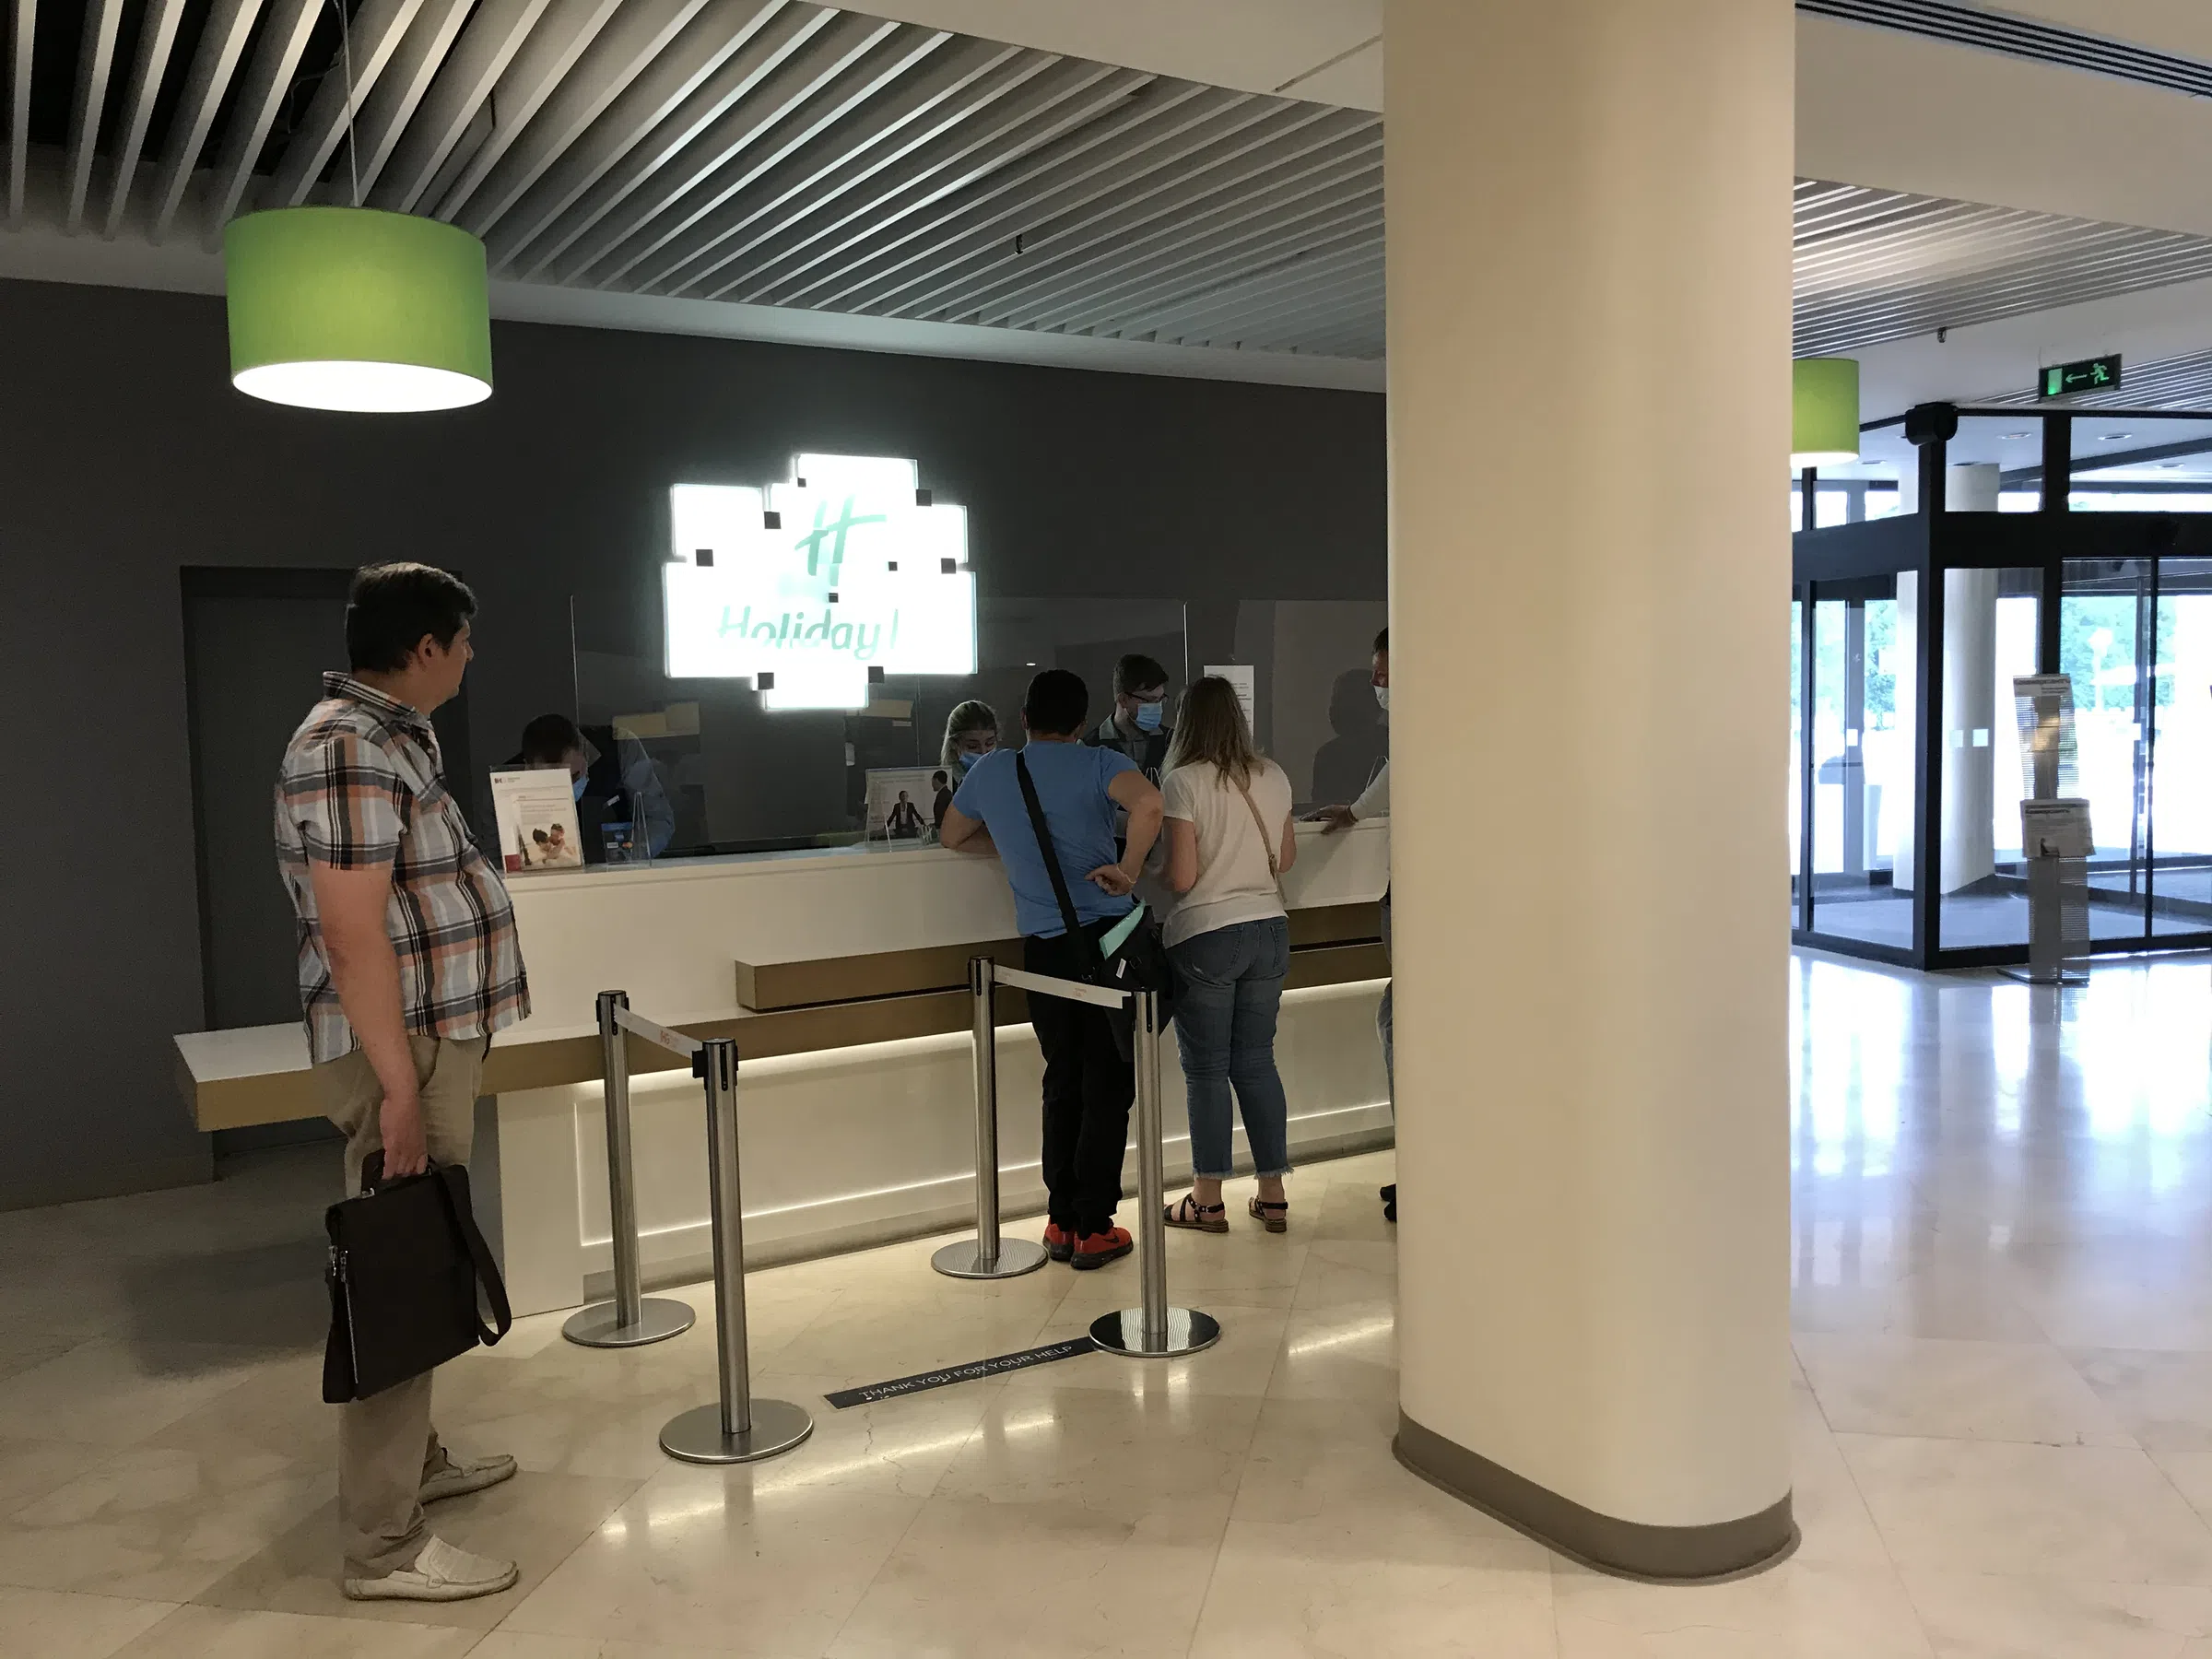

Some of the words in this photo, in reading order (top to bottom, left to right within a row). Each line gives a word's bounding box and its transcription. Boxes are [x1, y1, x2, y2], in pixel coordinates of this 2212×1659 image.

[715, 605, 881, 662] Holiday
[859, 1382, 916, 1398] THANK
[916, 1373, 951, 1385] YOU
[953, 1365, 989, 1377] FOR
[987, 1355, 1033, 1369] YOUR
[1034, 1345, 1073, 1359] HELP
